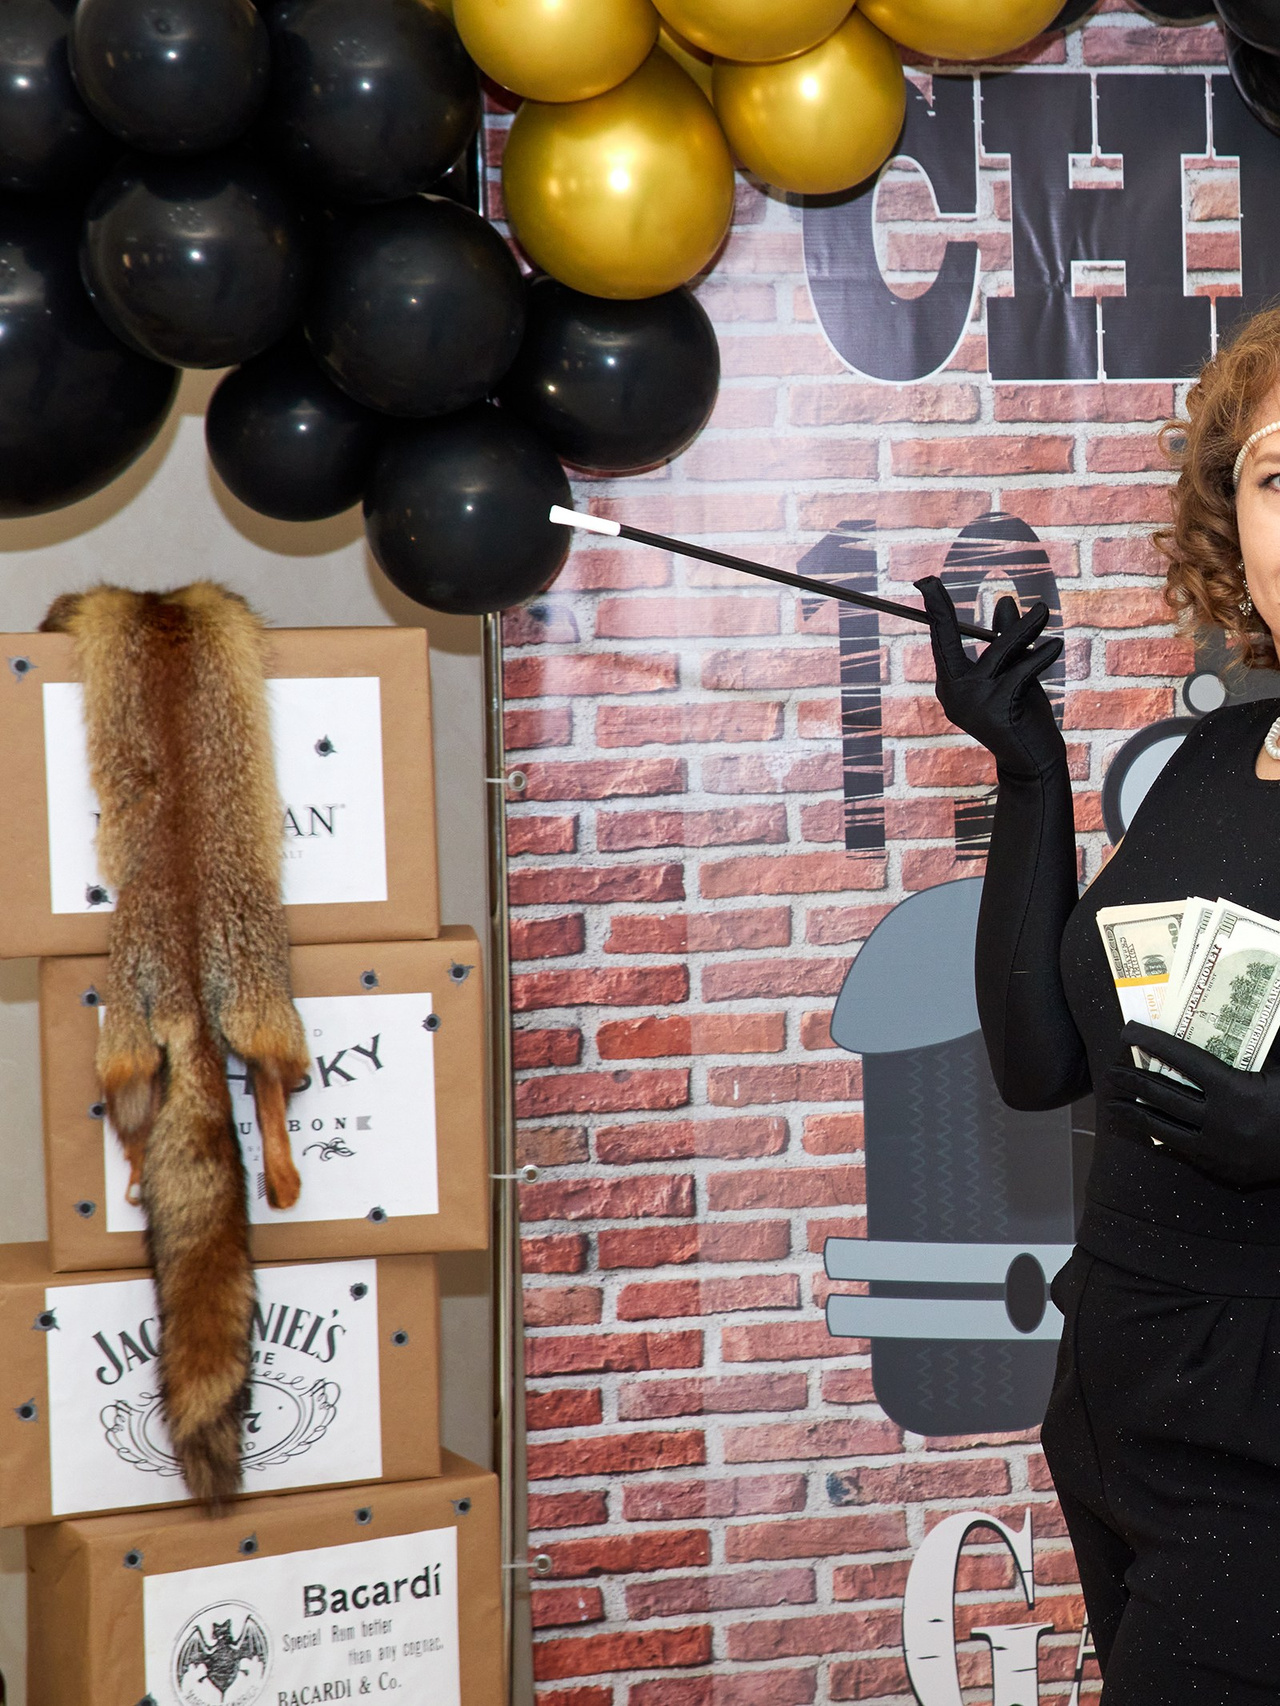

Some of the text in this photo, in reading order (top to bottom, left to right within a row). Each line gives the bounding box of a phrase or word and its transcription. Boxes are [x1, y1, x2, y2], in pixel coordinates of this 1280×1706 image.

[1199, 944, 1222, 987] MONEY
[302, 1562, 442, 1618] Bacardí
[282, 1627, 322, 1654] Special
[331, 1625, 356, 1643] Rum
[378, 1645, 398, 1662] any
[277, 1678, 352, 1706] BACARDI
[359, 1675, 372, 1695] &
[379, 1671, 403, 1691] Co.
